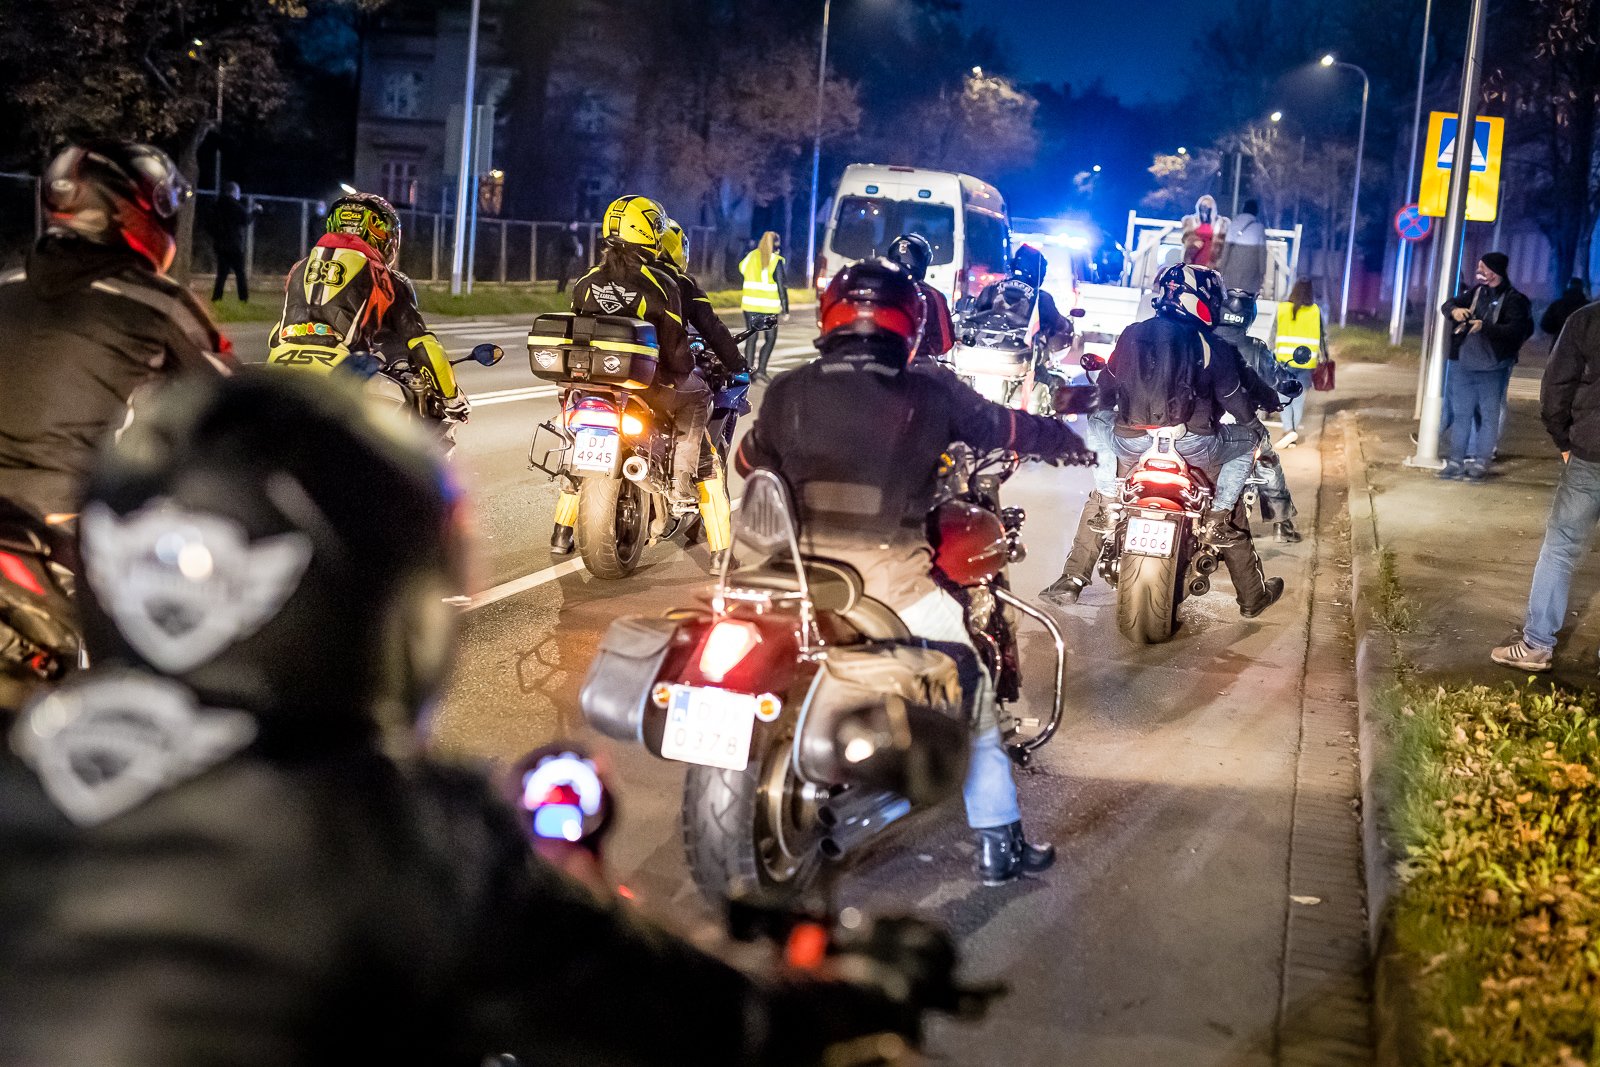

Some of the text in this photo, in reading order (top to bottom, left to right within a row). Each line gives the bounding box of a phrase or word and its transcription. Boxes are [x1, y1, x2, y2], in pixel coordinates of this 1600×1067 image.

[1223, 312, 1245, 324] EDDI
[588, 436, 607, 449] DJ
[577, 450, 613, 464] 4945
[1143, 524, 1159, 534] DJ
[1130, 537, 1167, 550] 6006
[675, 728, 737, 755] 0378
